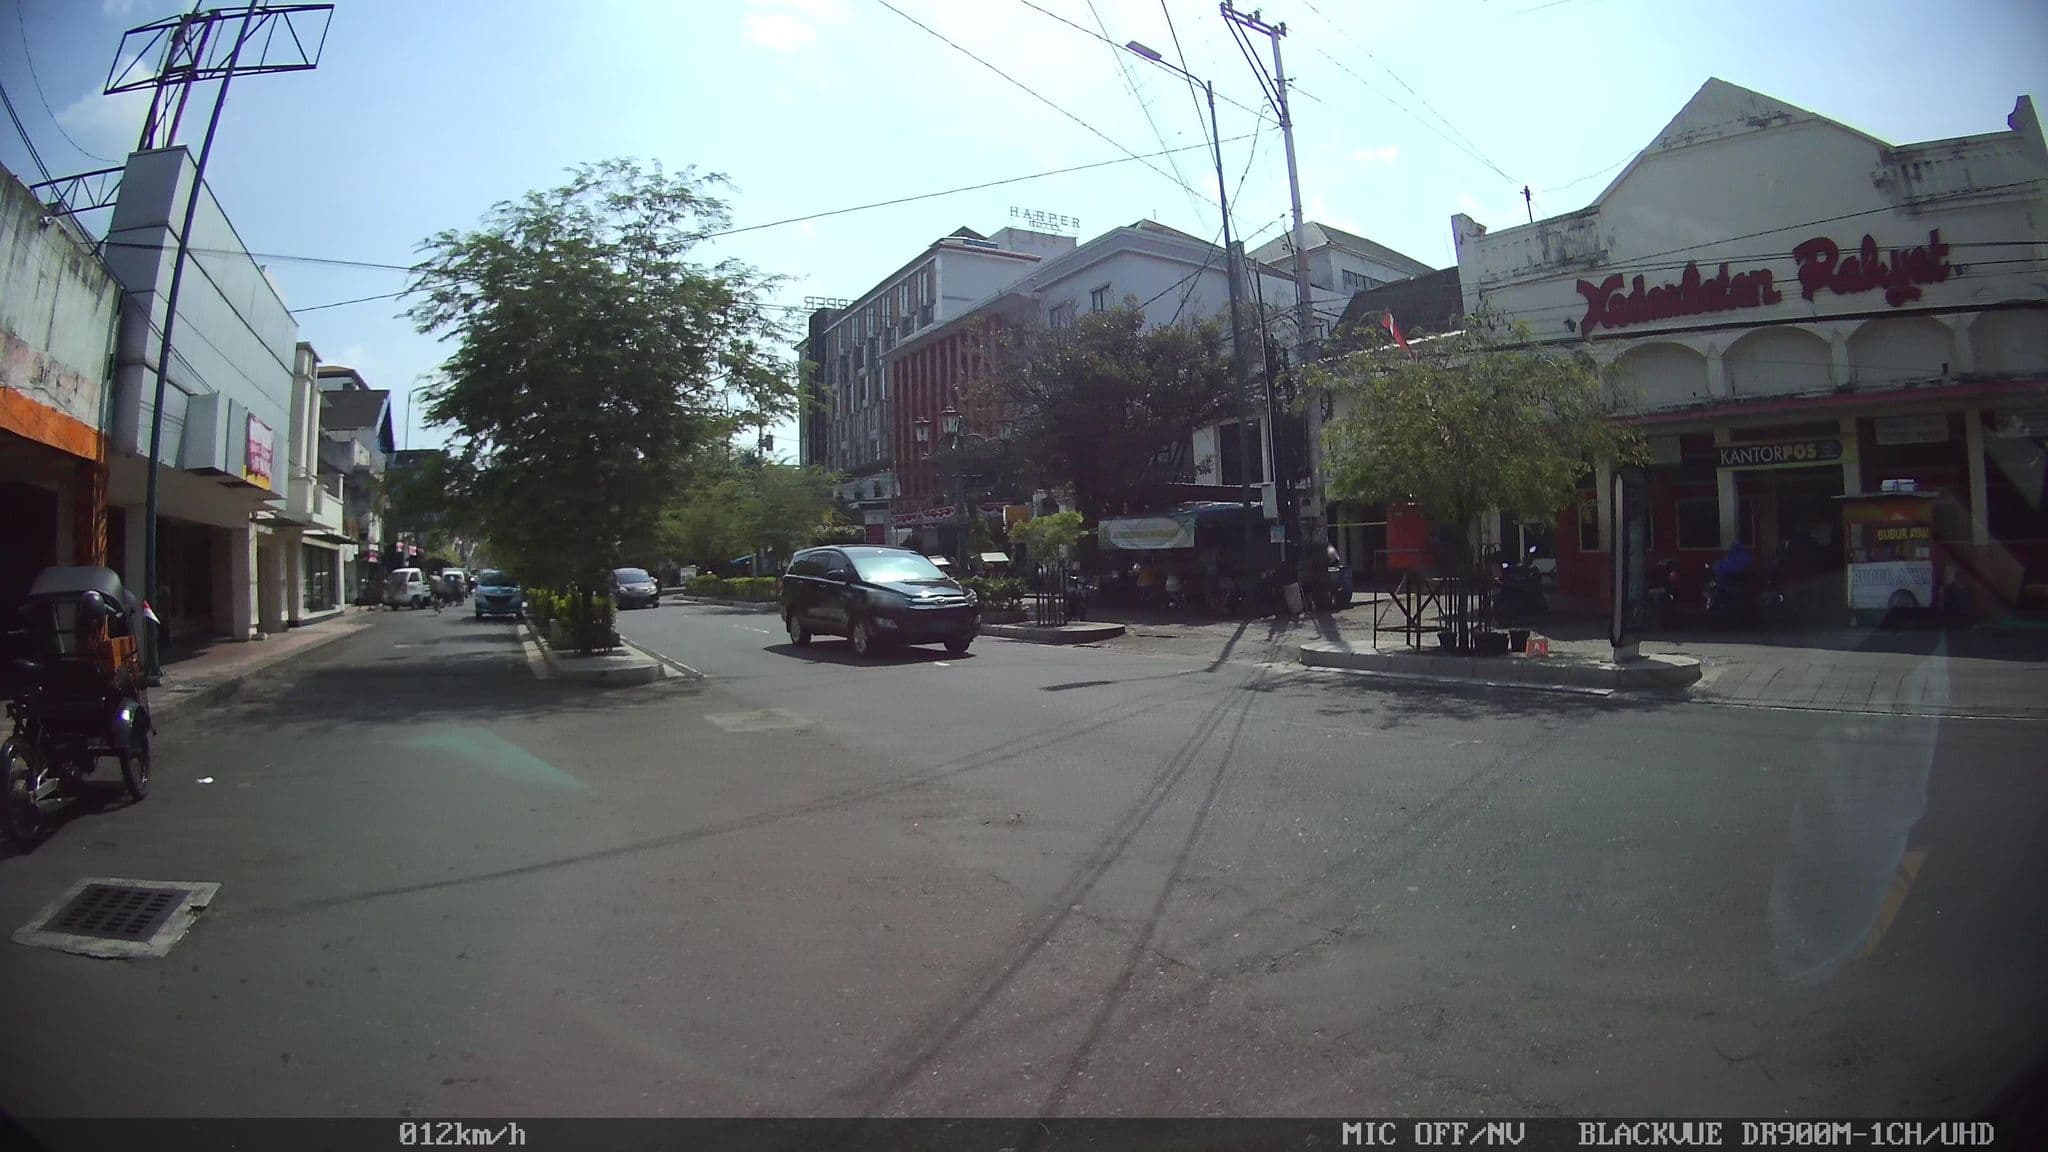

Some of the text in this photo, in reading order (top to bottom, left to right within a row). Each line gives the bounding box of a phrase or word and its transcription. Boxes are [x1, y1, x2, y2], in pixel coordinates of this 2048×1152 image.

[1009, 206, 1080, 228] HARPER
[1793, 229, 1951, 306] Rakyat
[1877, 528, 1908, 541] BUBUR
